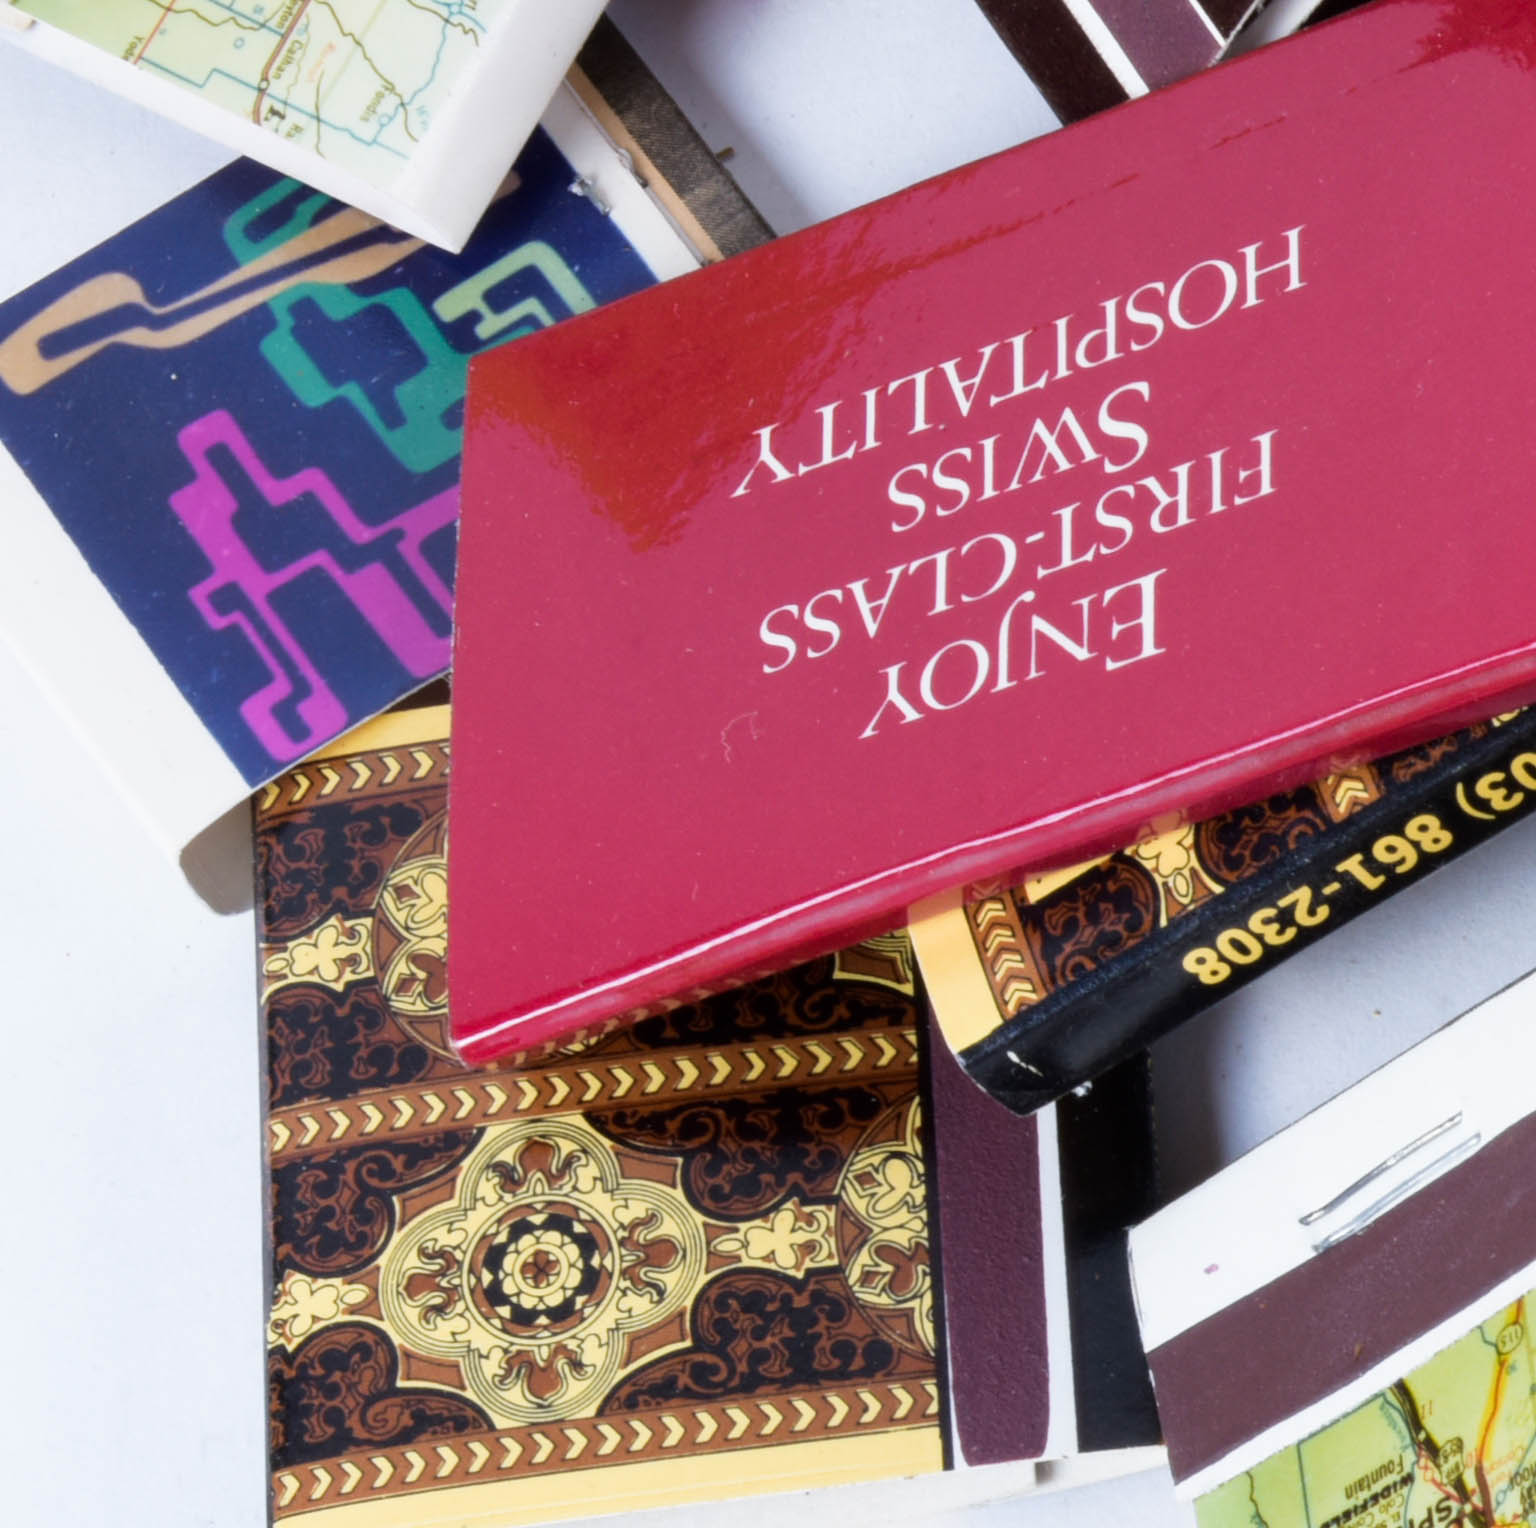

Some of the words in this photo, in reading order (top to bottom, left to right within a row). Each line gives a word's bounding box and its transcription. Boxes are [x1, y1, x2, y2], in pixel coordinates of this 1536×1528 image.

[728, 224, 1308, 498] HOSPITALITY
[888, 380, 1151, 533] SWISS
[757, 429, 1280, 674] FIRST-CLASS
[857, 567, 1168, 739] ENJOY
[1181, 812, 1453, 986] 861-2308
[1343, 1451, 1405, 1505] Fountain
[1374, 1492, 1405, 1522] Colo
